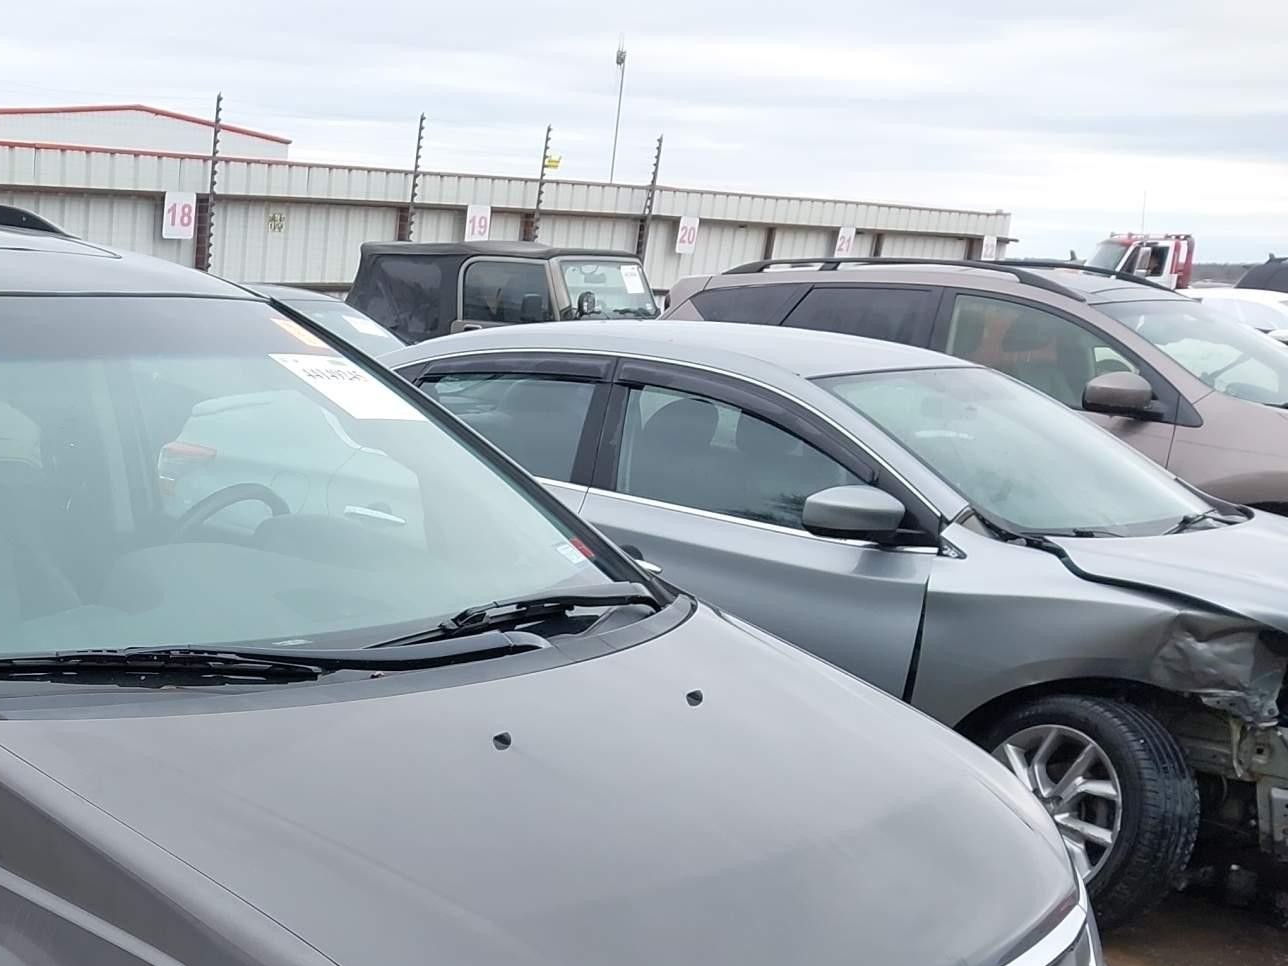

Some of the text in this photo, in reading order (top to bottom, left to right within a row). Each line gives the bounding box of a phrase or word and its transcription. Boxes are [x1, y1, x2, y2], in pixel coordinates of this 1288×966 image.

[167, 202, 193, 228] 18
[469, 215, 488, 237] 19
[679, 225, 696, 245] 20
[837, 235, 852, 253] 21
